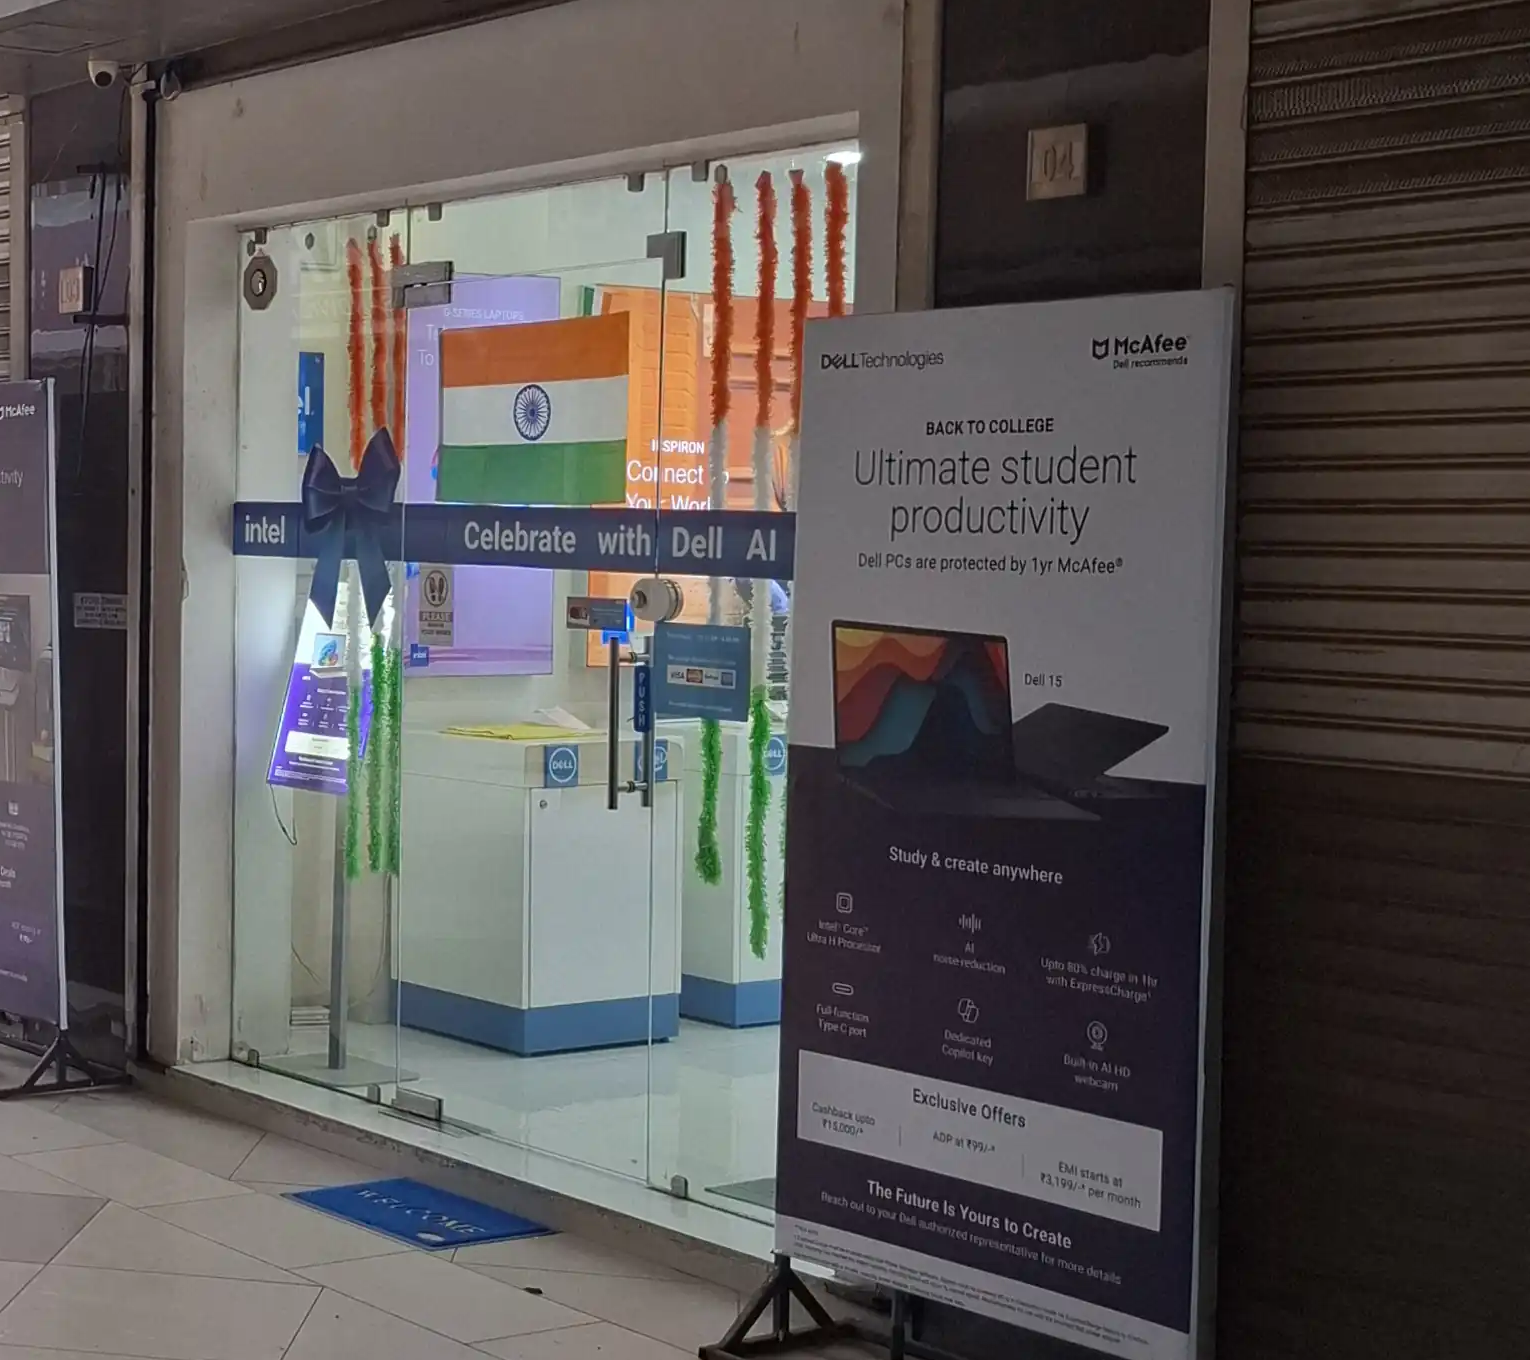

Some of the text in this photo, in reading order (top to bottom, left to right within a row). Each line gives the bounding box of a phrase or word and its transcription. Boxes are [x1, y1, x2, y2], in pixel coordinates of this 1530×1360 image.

[483, 309, 524, 321] LAPTOPS
[1114, 334, 1188, 356] McAfee
[821, 350, 944, 371] DELL Technologies
[1113, 356, 1188, 369] Dell recommends
[5, 404, 36, 417] McAfee
[926, 418, 1054, 436] BACK TO COLLEGE
[651, 440, 705, 454] ISPIRON
[854, 446, 1138, 486] Ultimate student
[891, 496, 1090, 546] productivity
[244, 515, 777, 564] intel Celebrate with Dell AI
[858, 553, 882, 569] Dell
[885, 554, 912, 570] PCs
[916, 558, 937, 570] are
[940, 555, 1007, 573] protected
[1010, 555, 1028, 576] by
[1032, 557, 1053, 576] 1yr
[1024, 673, 1063, 688] Dell 15
[638, 672, 646, 727] PUSH
[552, 758, 574, 769] DELL
[889, 846, 1063, 884] Study & create anywhere
[965, 943, 975, 954] AI
[1040, 956, 1065, 972] Upto
[1090, 966, 1125, 983] charge
[1046, 975, 1068, 988] with
[819, 1018, 839, 1033] Type
[849, 1025, 867, 1038] port
[945, 1030, 991, 1049] Dedicated
[942, 1044, 994, 1067] Copilot key
[1115, 1065, 1131, 1078] HD
[1074, 1074, 1119, 1092] webcam
[811, 1102, 876, 1126] Cashback upto
[913, 1088, 1026, 1128] Exclusive Offers
[1058, 1161, 1123, 1188] EMI starts at
[1088, 1187, 1104, 1199] per
[1107, 1192, 1141, 1209] month
[867, 1180, 1072, 1249] The Future Is Yours to Create
[821, 1191, 1122, 1285] Reach out to your Dell authorized representative for more details
